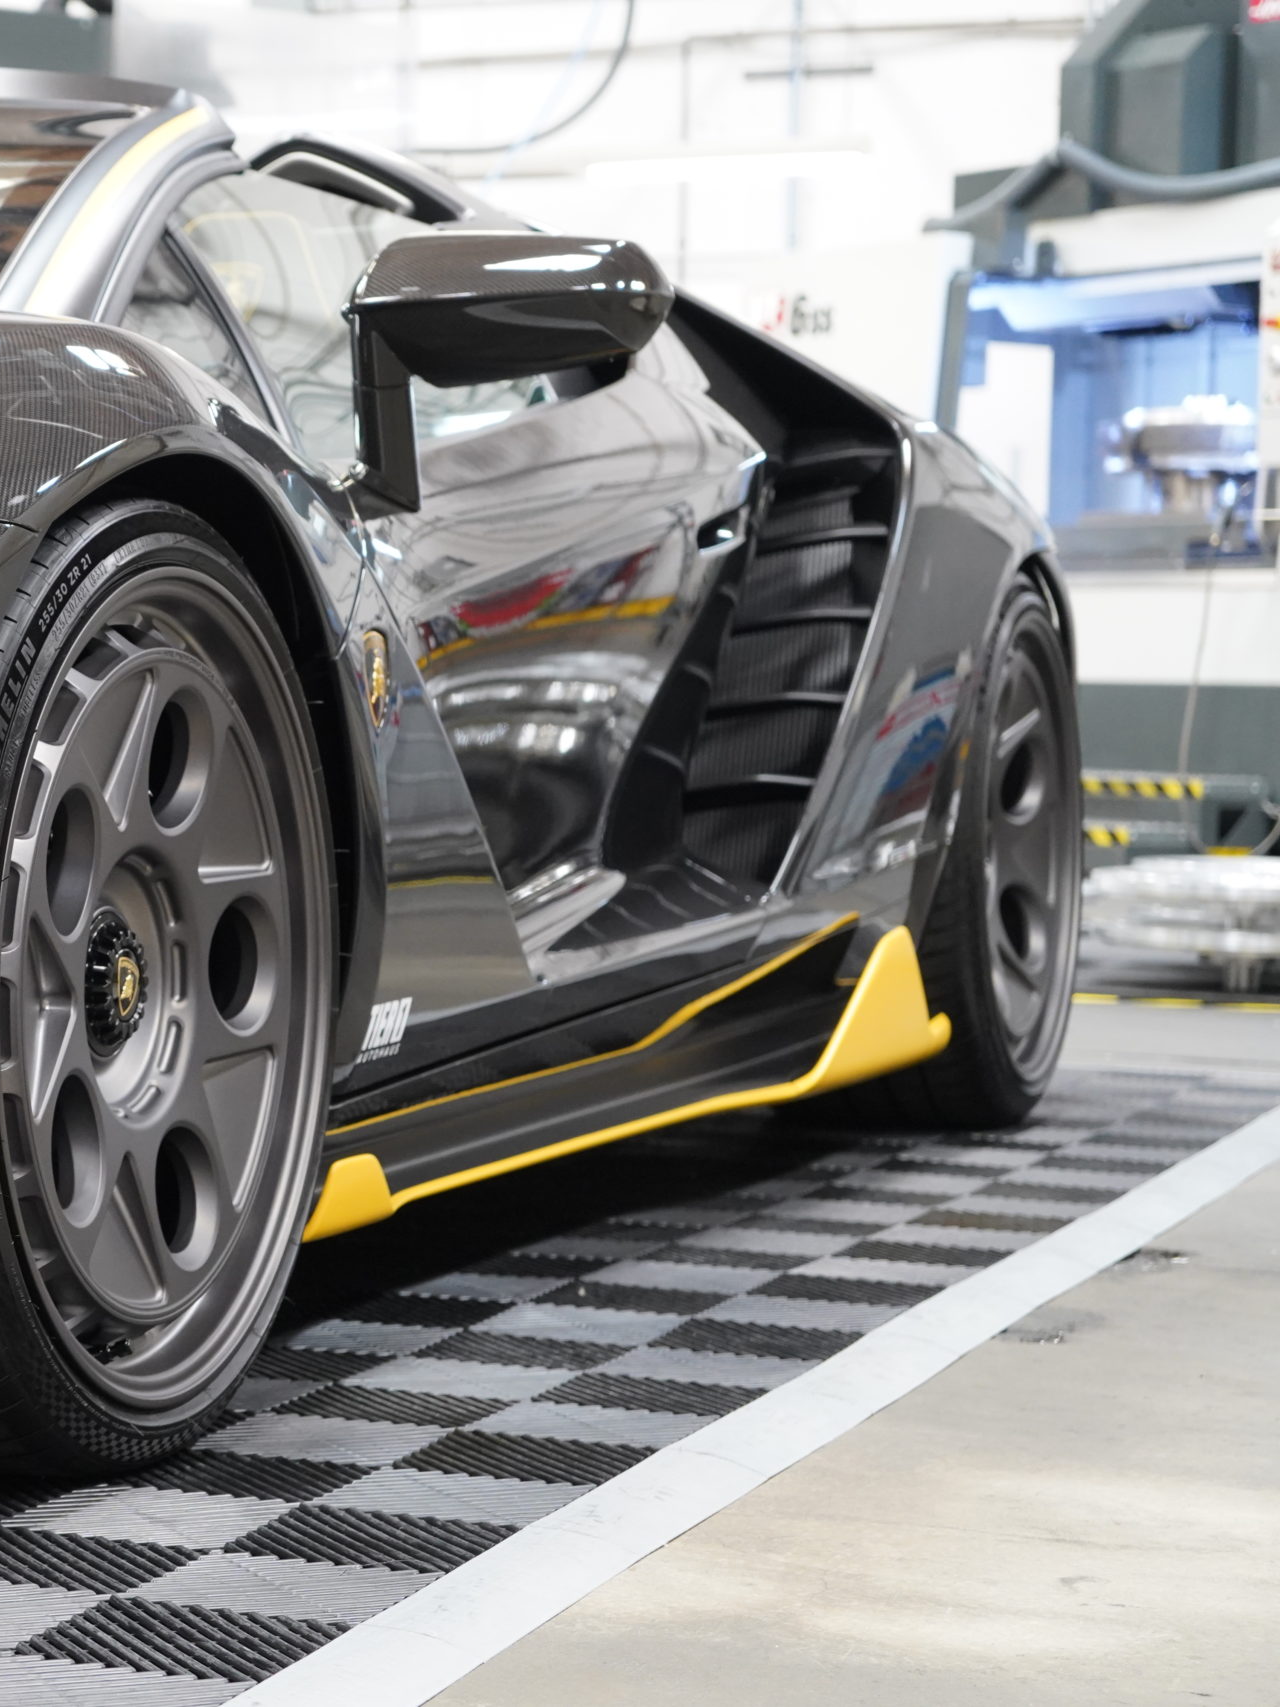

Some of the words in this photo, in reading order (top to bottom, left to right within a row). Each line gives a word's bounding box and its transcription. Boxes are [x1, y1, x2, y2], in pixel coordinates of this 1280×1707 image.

[38, 582, 68, 632] 255/30
[67, 568, 83, 587] ZR
[80, 553, 93, 572] 21
